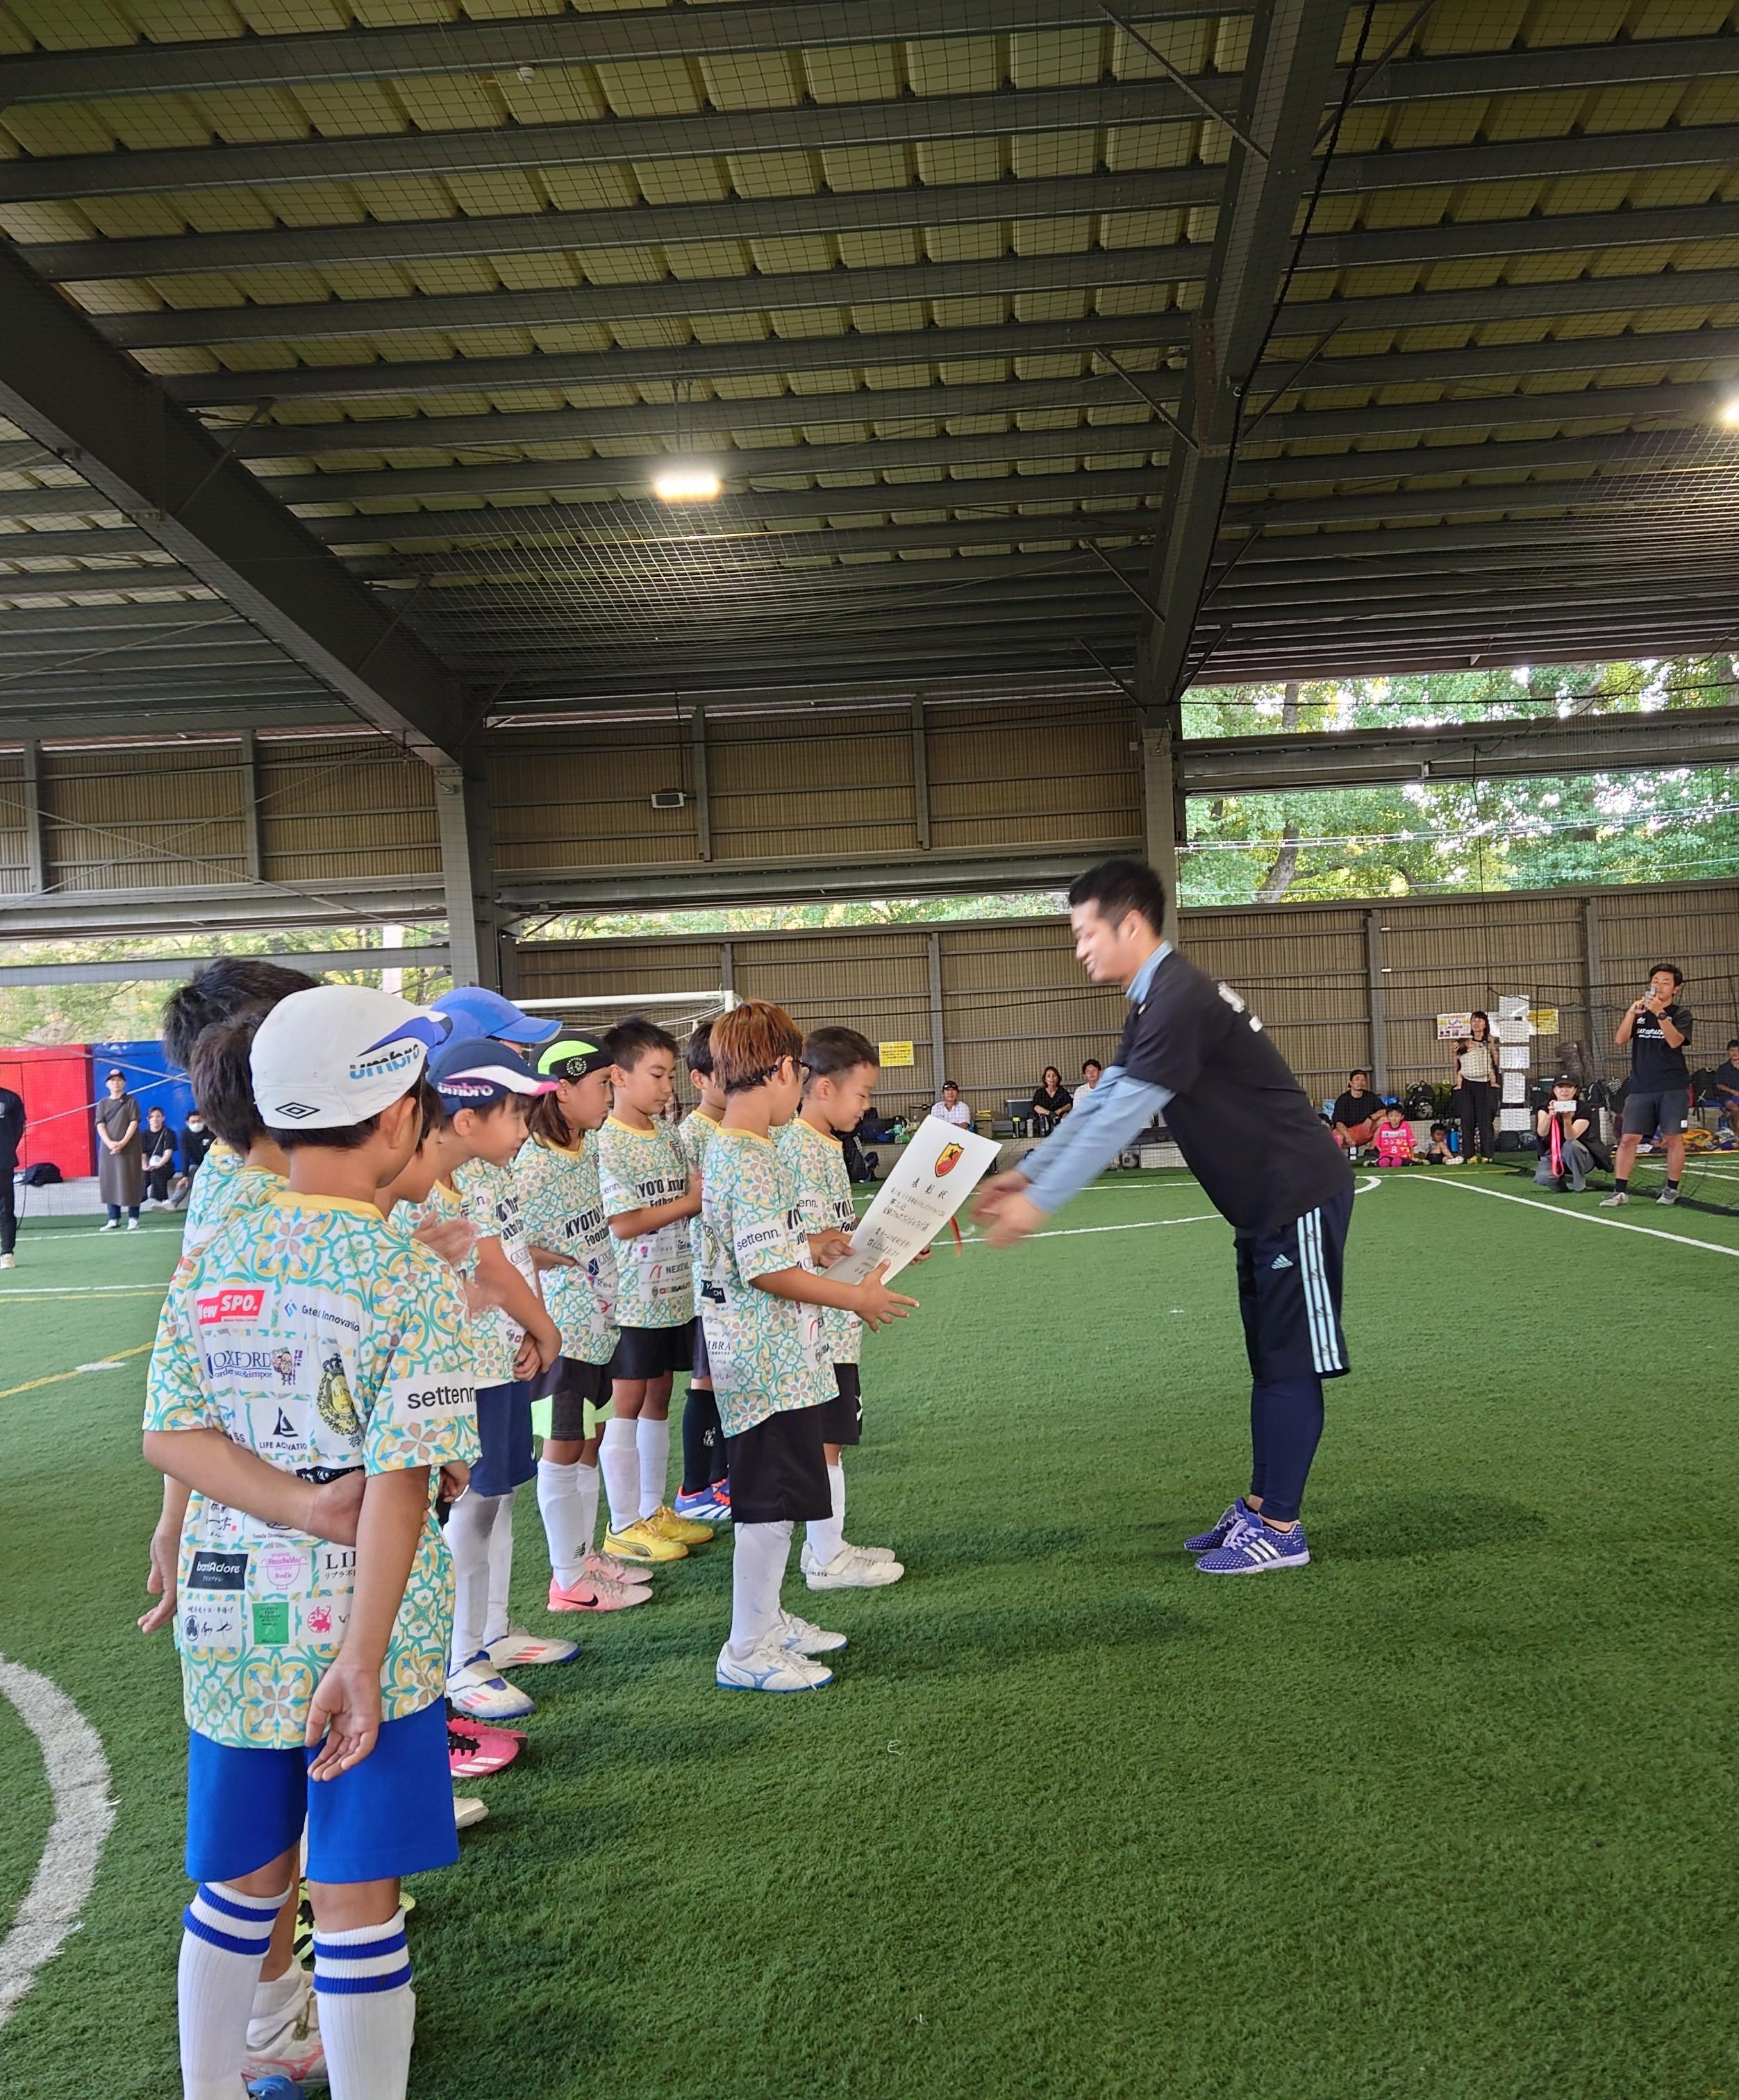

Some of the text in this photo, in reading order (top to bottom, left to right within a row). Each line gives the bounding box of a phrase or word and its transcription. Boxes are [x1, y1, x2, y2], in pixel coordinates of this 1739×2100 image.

[438, 1082, 494, 1097] umbro
[219, 1294, 258, 1312] SPO.
[213, 1350, 272, 1368] OXFORD
